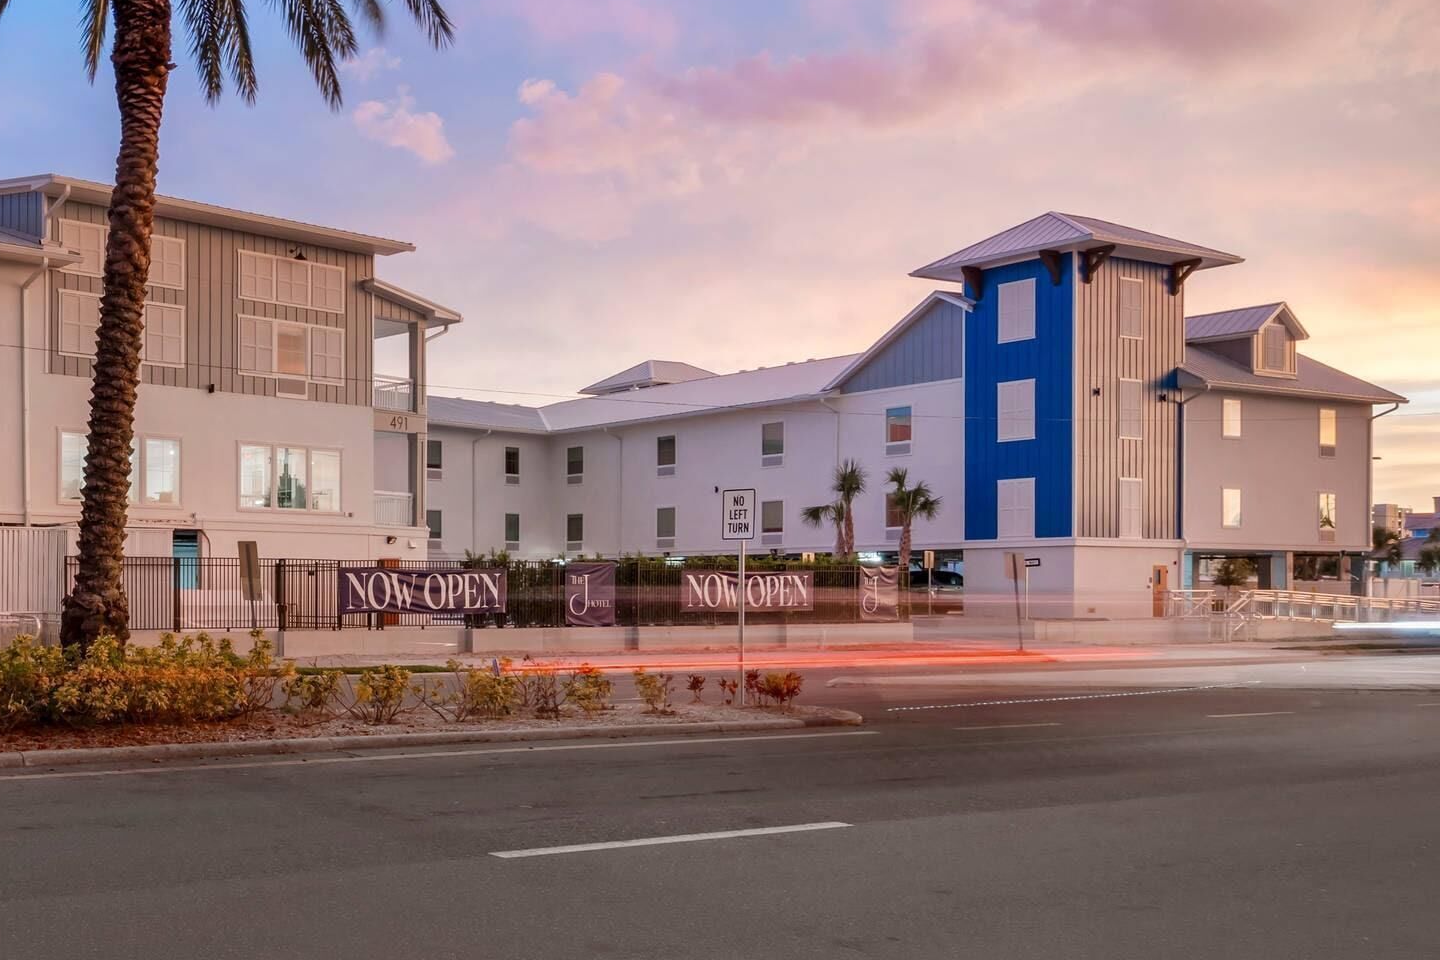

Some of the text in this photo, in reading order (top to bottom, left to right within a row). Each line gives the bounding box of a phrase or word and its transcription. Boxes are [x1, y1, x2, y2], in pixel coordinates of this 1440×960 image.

[390, 415, 408, 431] 491
[733, 495, 745, 507] NO
[729, 509, 748, 520] LEFT
[727, 522, 749, 533] TURN
[345, 572, 502, 610] NOW OPEN
[570, 574, 612, 616] THE J HOTEL
[686, 574, 809, 608] NOW OPEN
